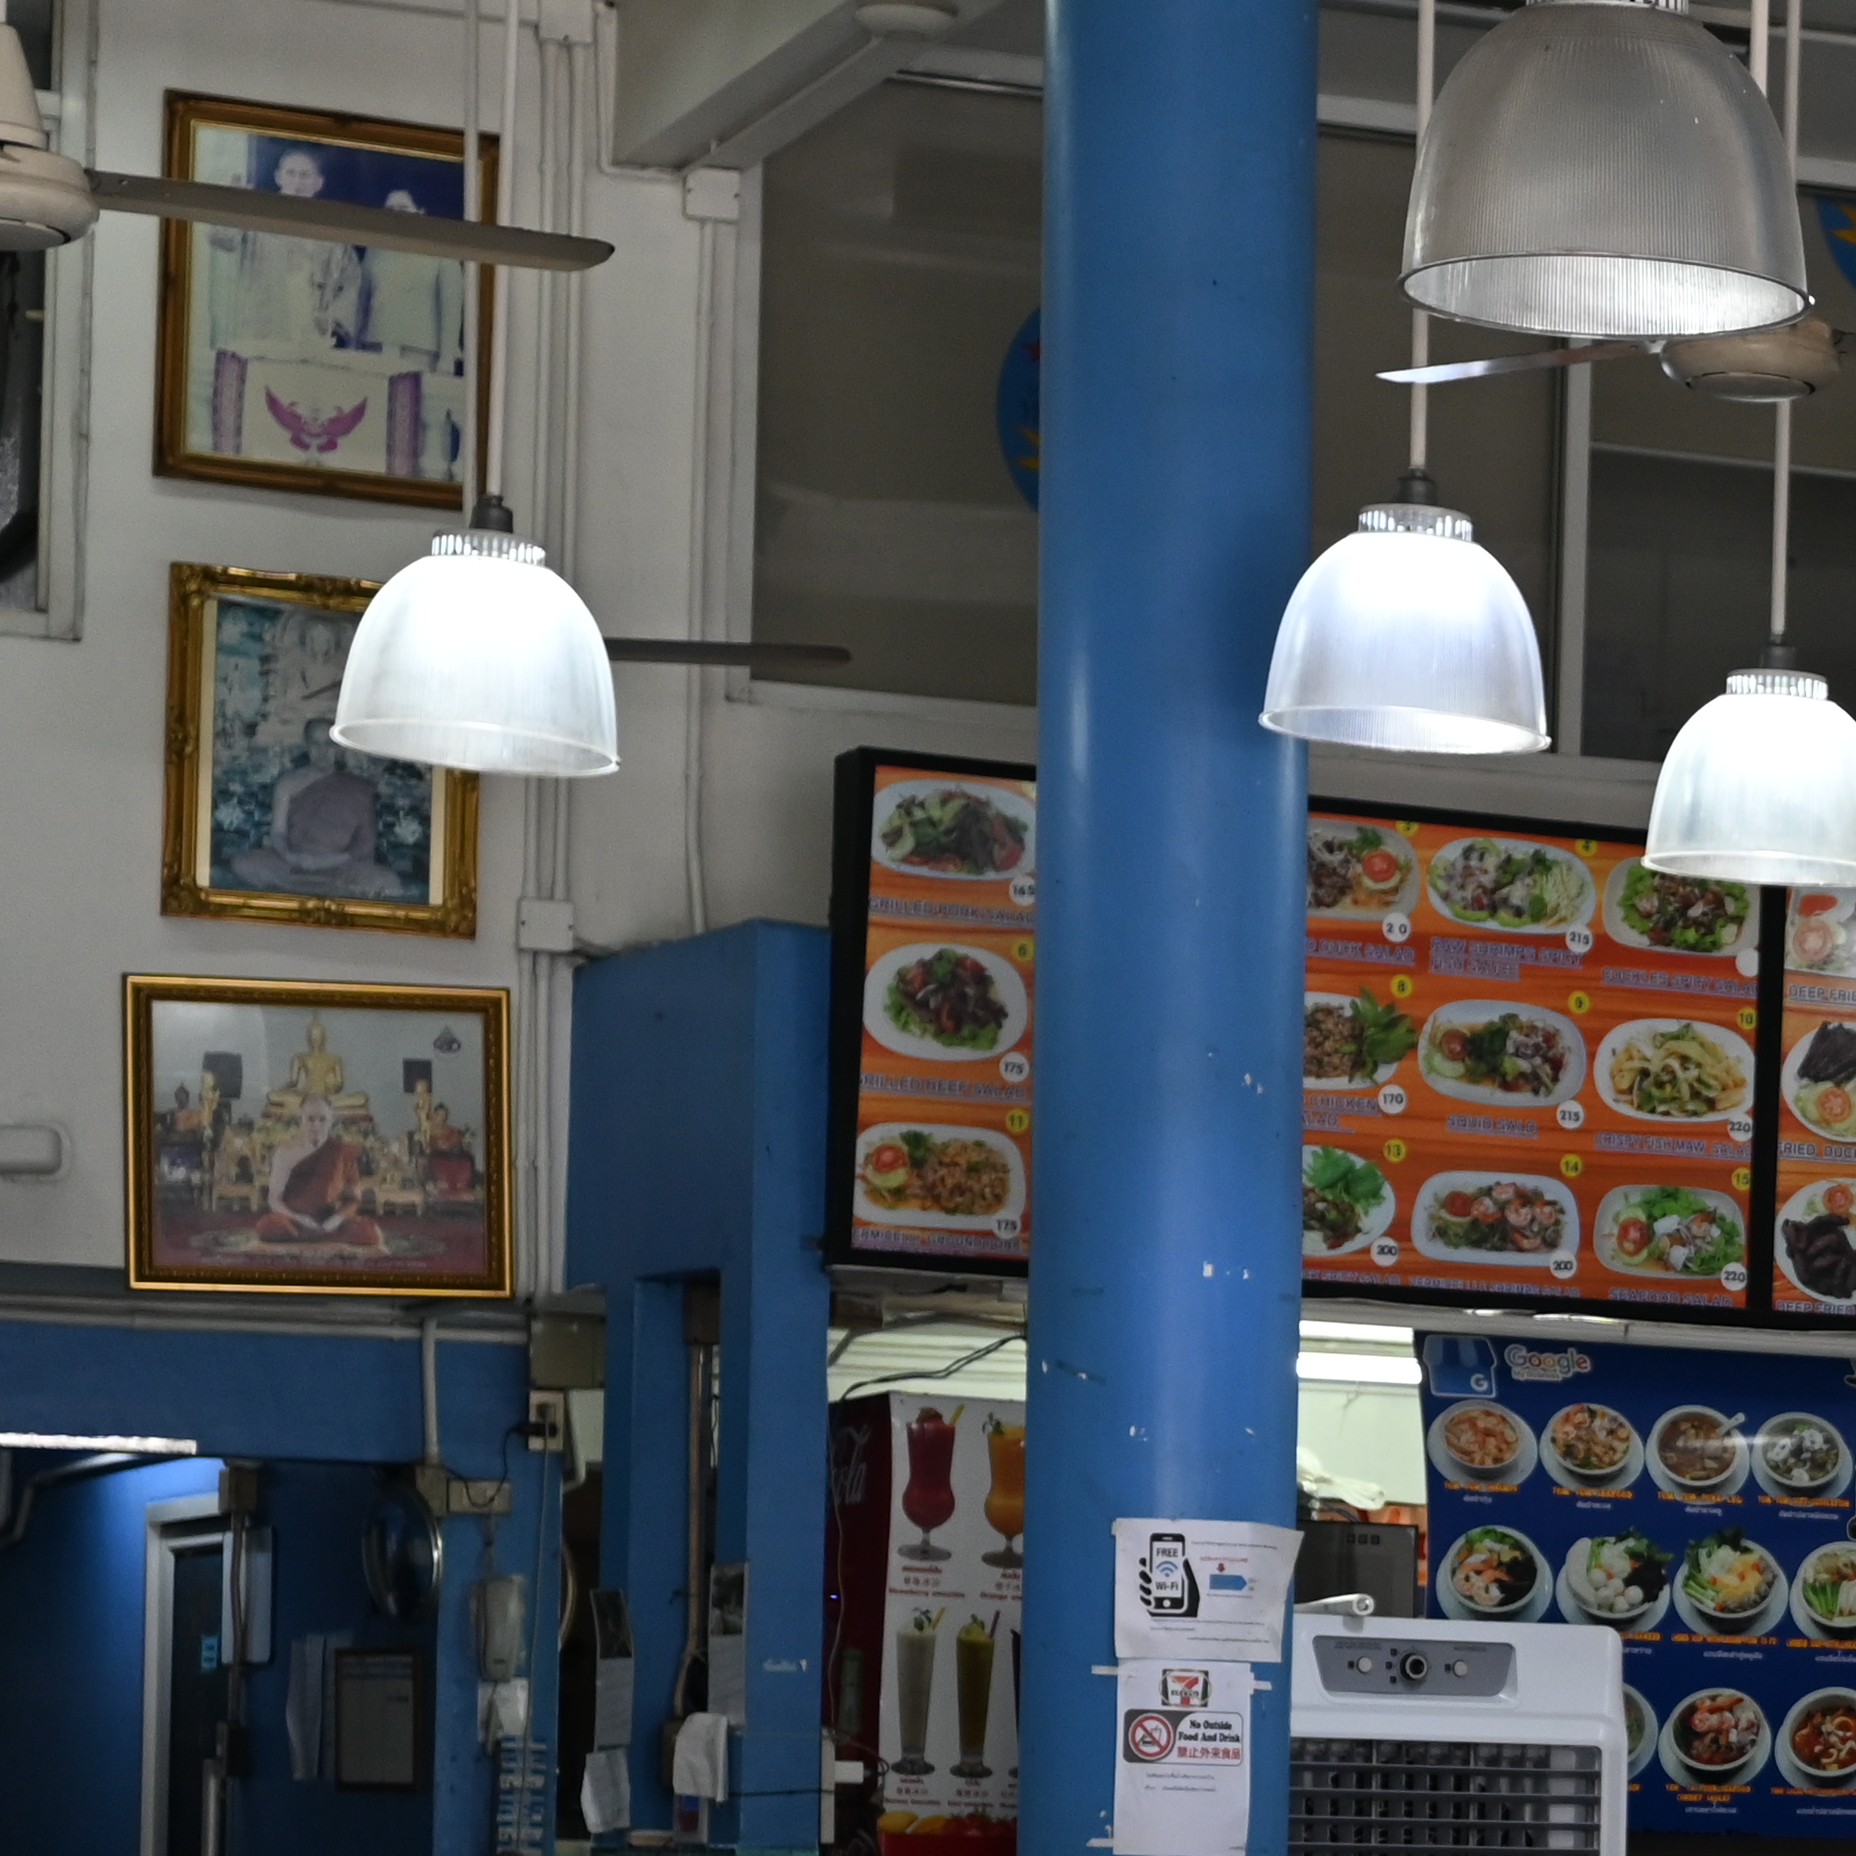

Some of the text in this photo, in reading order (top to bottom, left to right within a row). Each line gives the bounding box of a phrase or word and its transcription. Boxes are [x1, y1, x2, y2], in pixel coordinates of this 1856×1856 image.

[1568, 931, 1590, 946] 215
[1789, 984, 1827, 1000] DEEP
[1740, 1012, 1754, 1025] 10
[1003, 1061, 1024, 1075] 175
[973, 1082, 1027, 1100] SALAD
[1310, 1094, 1378, 1112] CHICKEN
[1383, 1093, 1404, 1106] 170
[1010, 1114, 1024, 1127] 11
[1559, 1108, 1581, 1122] 215
[1448, 1114, 1493, 1130] SQUID
[1728, 1120, 1752, 1133] 220
[1595, 1131, 1706, 1154] CRISPY FISH MAW
[1778, 1140, 1816, 1157] FRIED
[1563, 1159, 1580, 1172] 14
[1734, 1172, 1751, 1186] 15
[996, 1219, 1018, 1232] 175
[1376, 1244, 1399, 1257] 200
[1552, 1259, 1574, 1272] 200
[1723, 1270, 1746, 1283] 220
[1609, 1287, 1681, 1304] SEAFOOD
[1505, 1345, 1591, 1375] Google
[1470, 1373, 1489, 1392] G
[1156, 1547, 1179, 1559] FREE
[1155, 1581, 1179, 1592] Wi-Fi
[1189, 1719, 1233, 1731] No Outside
[1178, 1732, 1241, 1743] Food And Drink
